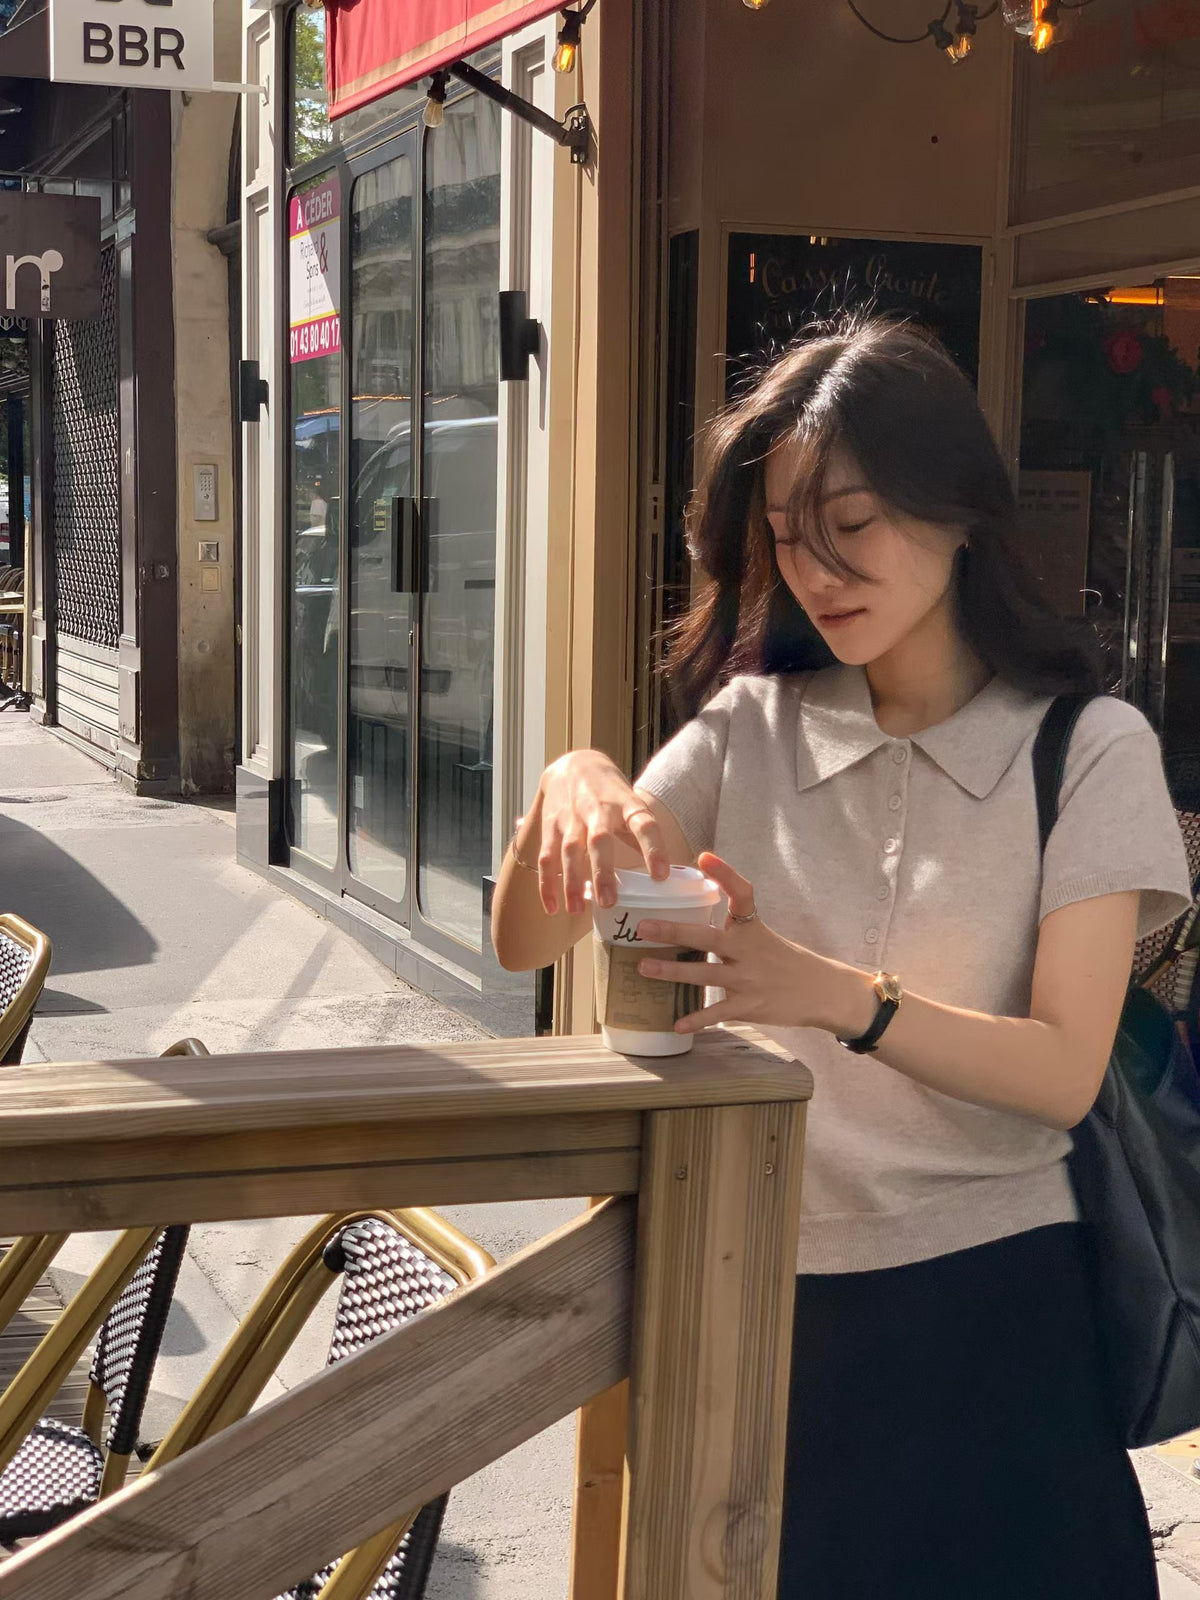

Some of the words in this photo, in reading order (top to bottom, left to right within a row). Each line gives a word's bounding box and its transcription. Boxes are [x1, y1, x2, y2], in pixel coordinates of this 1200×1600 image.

[83, 21, 186, 70] BBR
[304, 190, 334, 226] CÉDER
[299, 326, 309, 354] 43
[309, 323, 320, 353] 80
[320, 319, 329, 350] 40
[331, 317, 340, 347] 17
